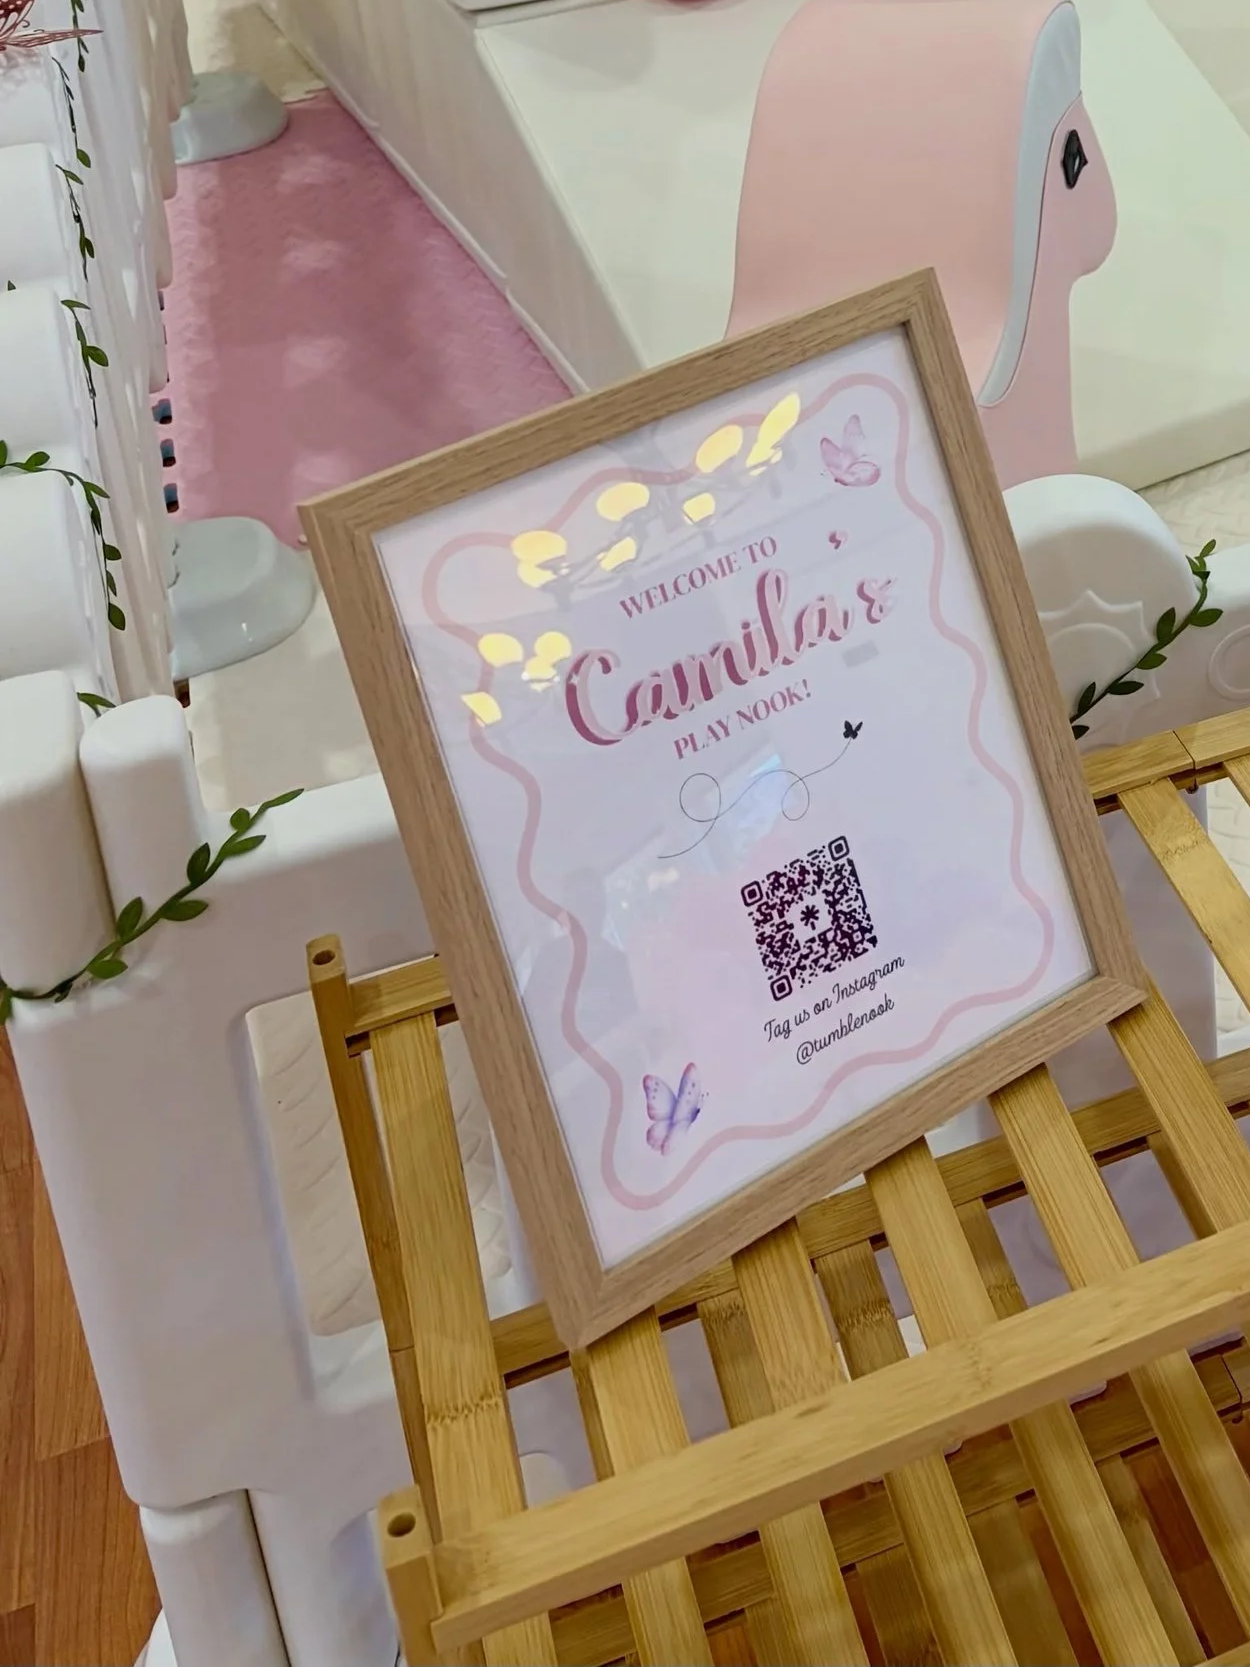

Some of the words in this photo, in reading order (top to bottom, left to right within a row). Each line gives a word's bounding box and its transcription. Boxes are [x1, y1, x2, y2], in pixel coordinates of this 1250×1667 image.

[619, 552, 742, 619] WELCOME
[742, 536, 777, 565] TO
[673, 714, 732, 760] PLAY
[735, 678, 812, 731] NOOK!
[763, 1018, 792, 1042] Tag
[793, 1009, 811, 1027] us
[813, 997, 833, 1015] on
[832, 957, 905, 1004] Instagram
[797, 993, 895, 1065] @tumblenook
